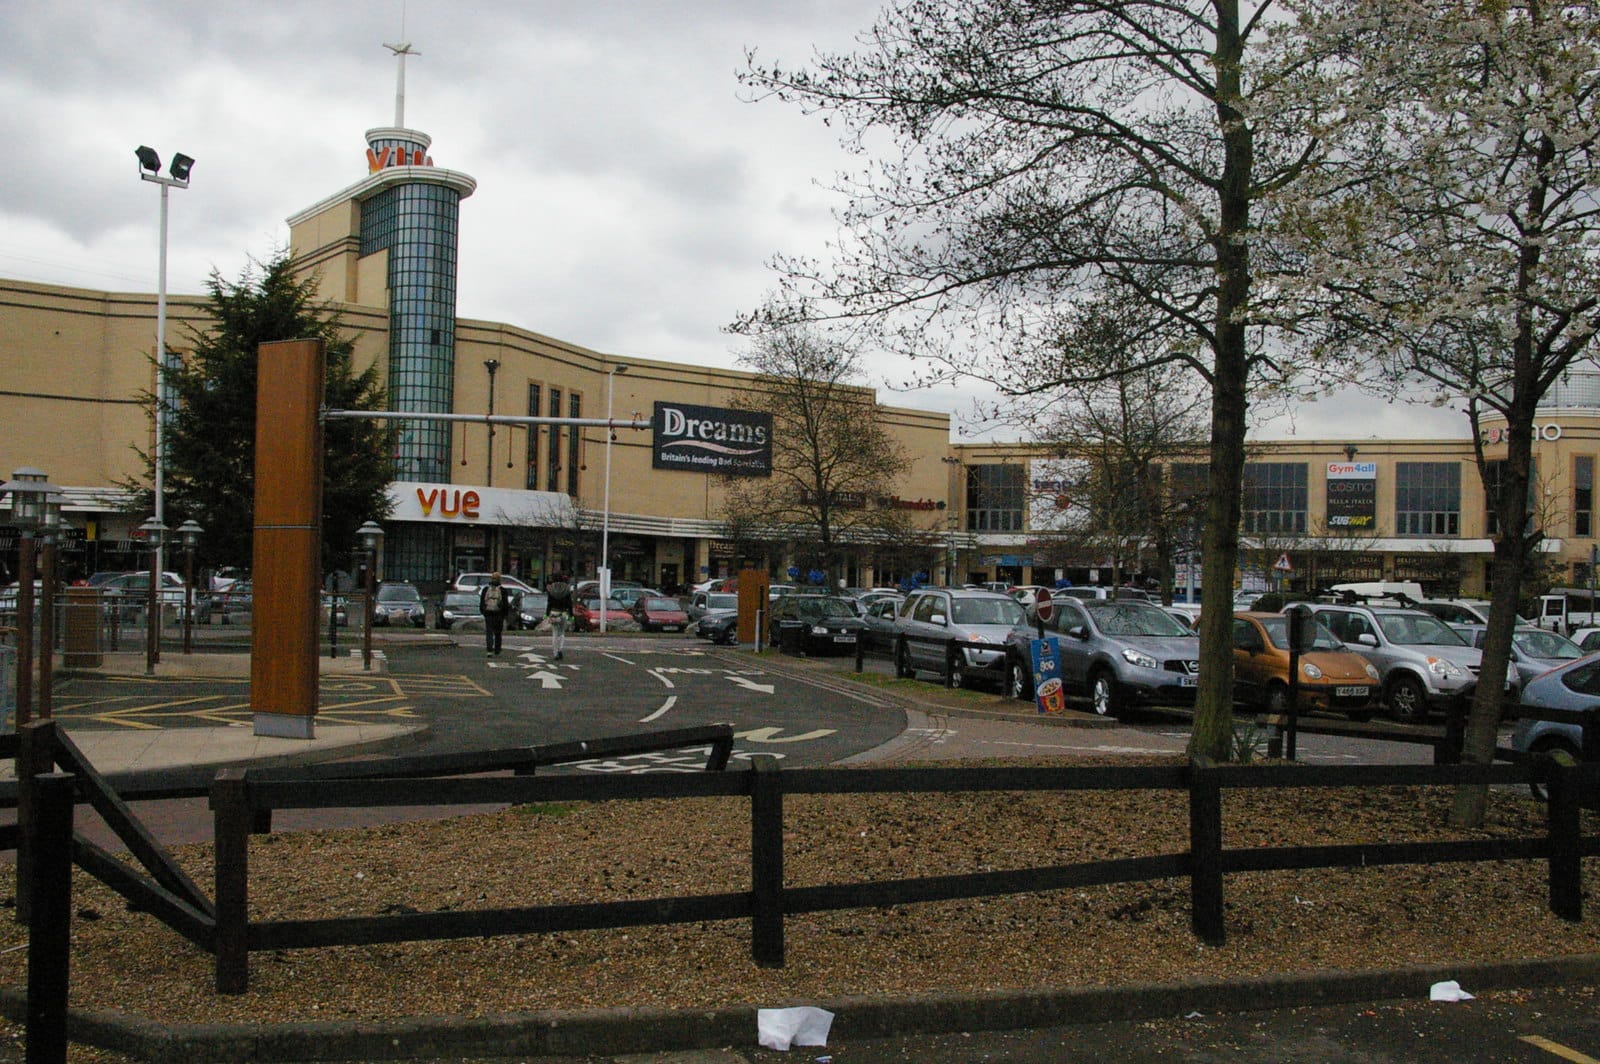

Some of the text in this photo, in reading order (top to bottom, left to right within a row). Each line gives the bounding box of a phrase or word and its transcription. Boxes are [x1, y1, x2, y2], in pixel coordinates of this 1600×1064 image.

[662, 408, 767, 445] Dreams
[661, 452, 691, 463] Britain's
[1328, 463, 1375, 475] Gym4all
[1328, 515, 1373, 526] SUBWAY
